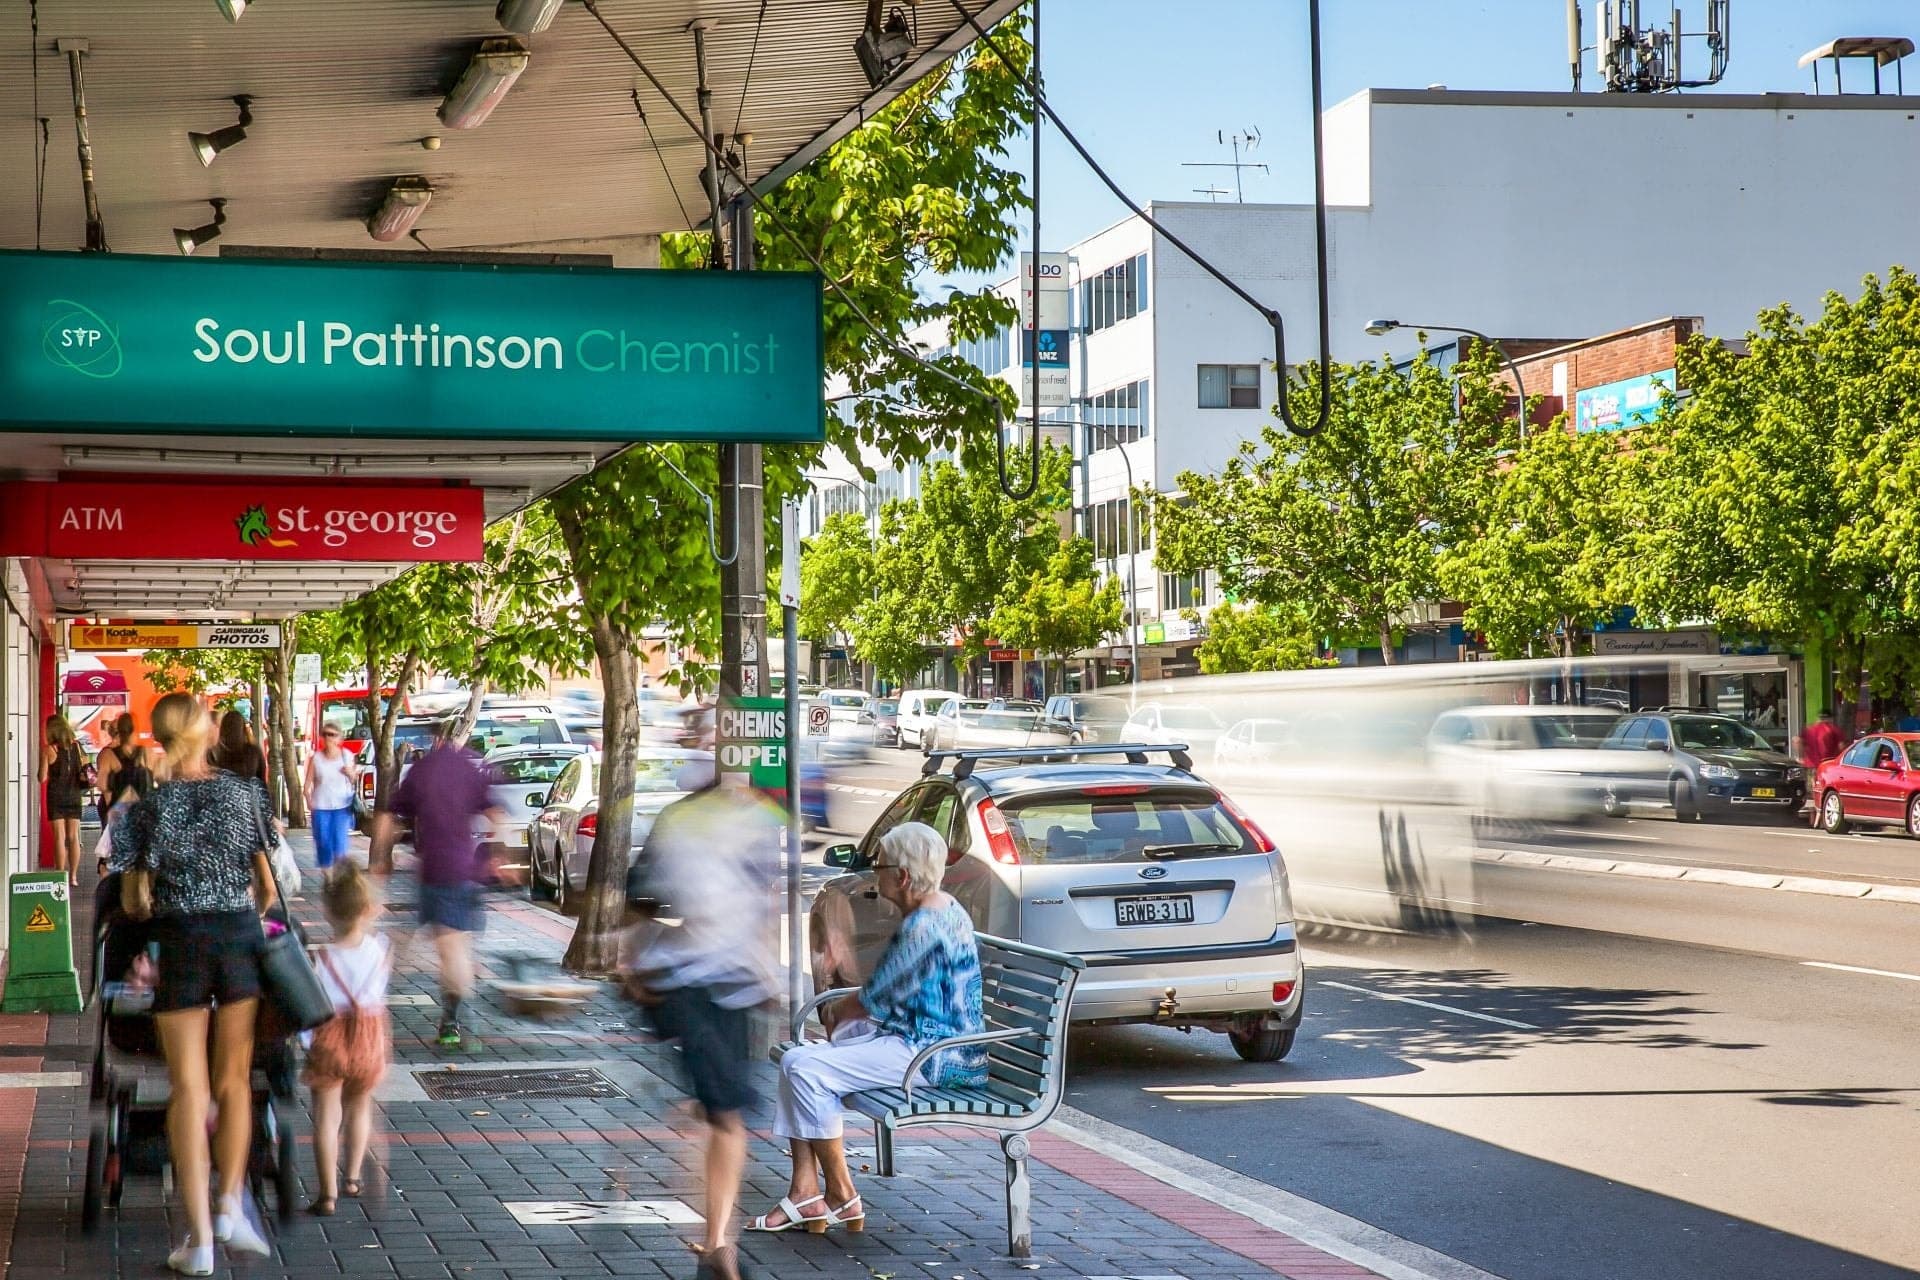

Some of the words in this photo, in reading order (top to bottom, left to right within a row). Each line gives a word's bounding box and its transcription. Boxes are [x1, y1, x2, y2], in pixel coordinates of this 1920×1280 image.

[192, 317, 306, 365] Soul
[323, 321, 563, 371] Pattinson
[575, 328, 780, 375] Chemist
[60, 507, 123, 531] ATM
[277, 505, 457, 547] st.george
[106, 627, 138, 637] Kodak
[119, 636, 180, 647] EXPRESS
[208, 634, 270, 644] PHOTOS
[720, 710, 786, 739] CHEMIS
[822, 726, 828, 734] U
[1145, 868, 1162, 877] Ford
